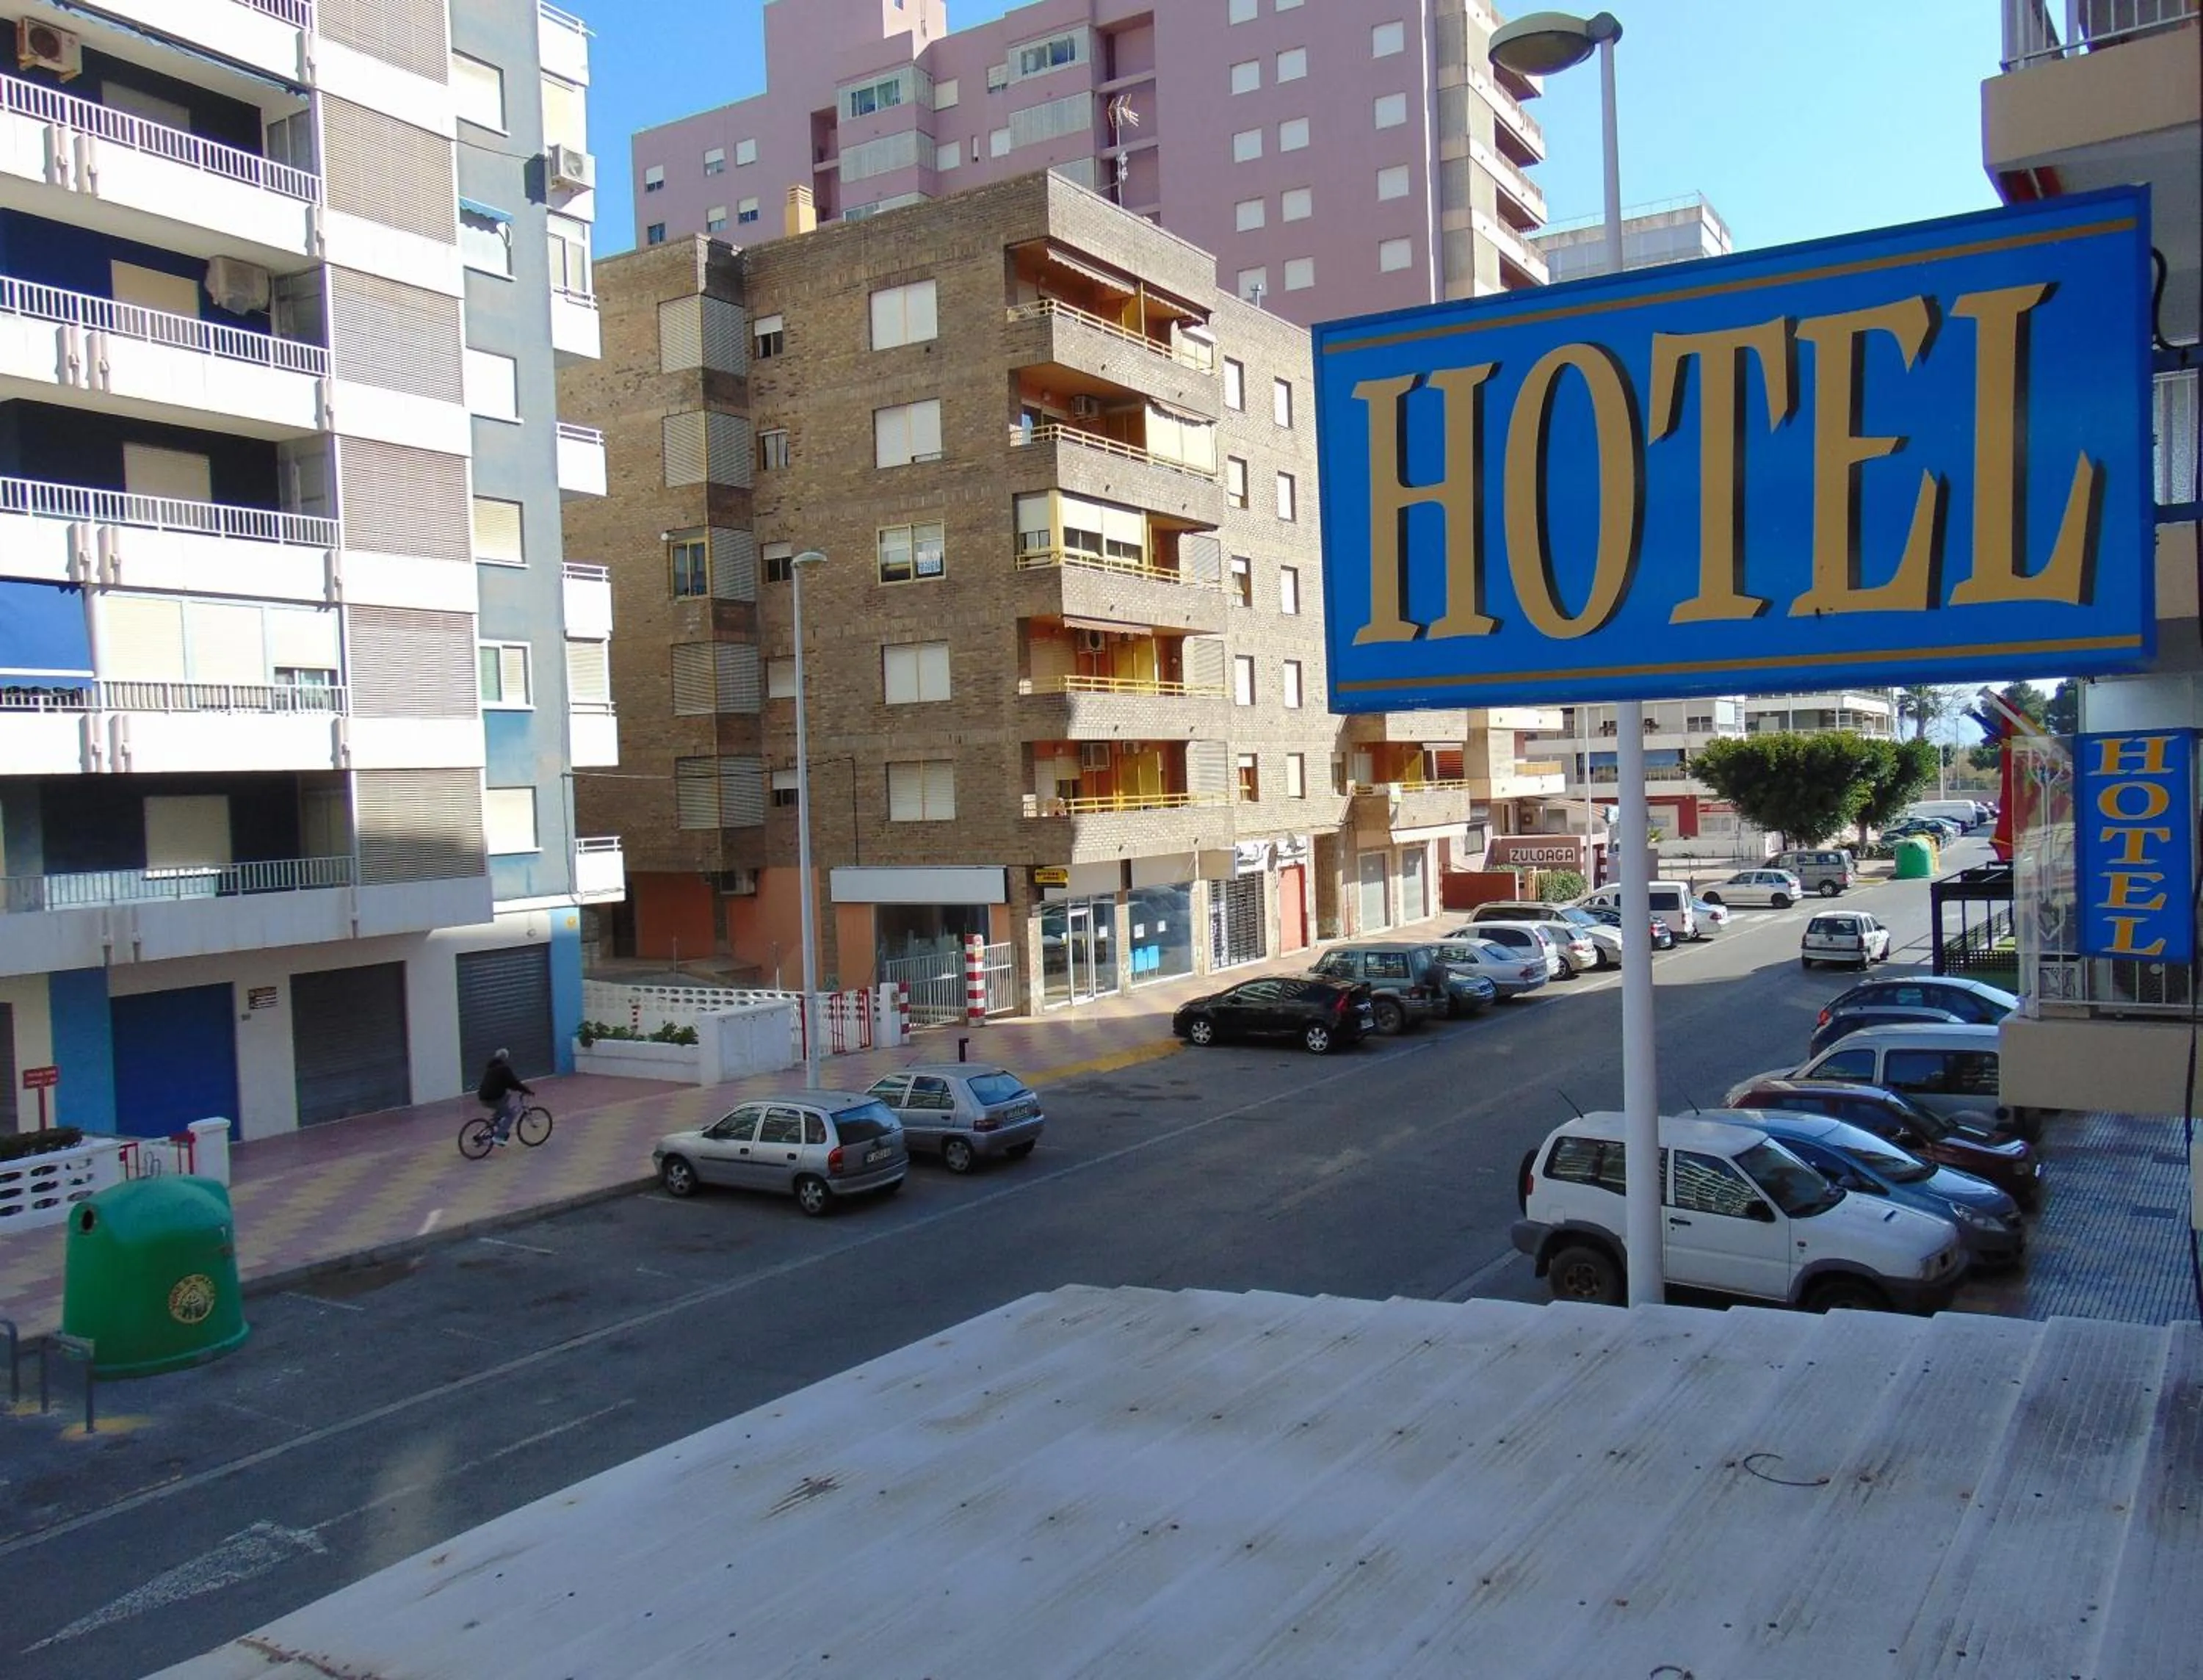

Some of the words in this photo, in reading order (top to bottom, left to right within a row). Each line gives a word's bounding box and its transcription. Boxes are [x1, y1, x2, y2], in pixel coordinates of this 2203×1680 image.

[1351, 283, 2104, 645] HOTEL
[1511, 849, 1574, 861] ZULOAGA
[2086, 736, 2179, 956] HOTEL
